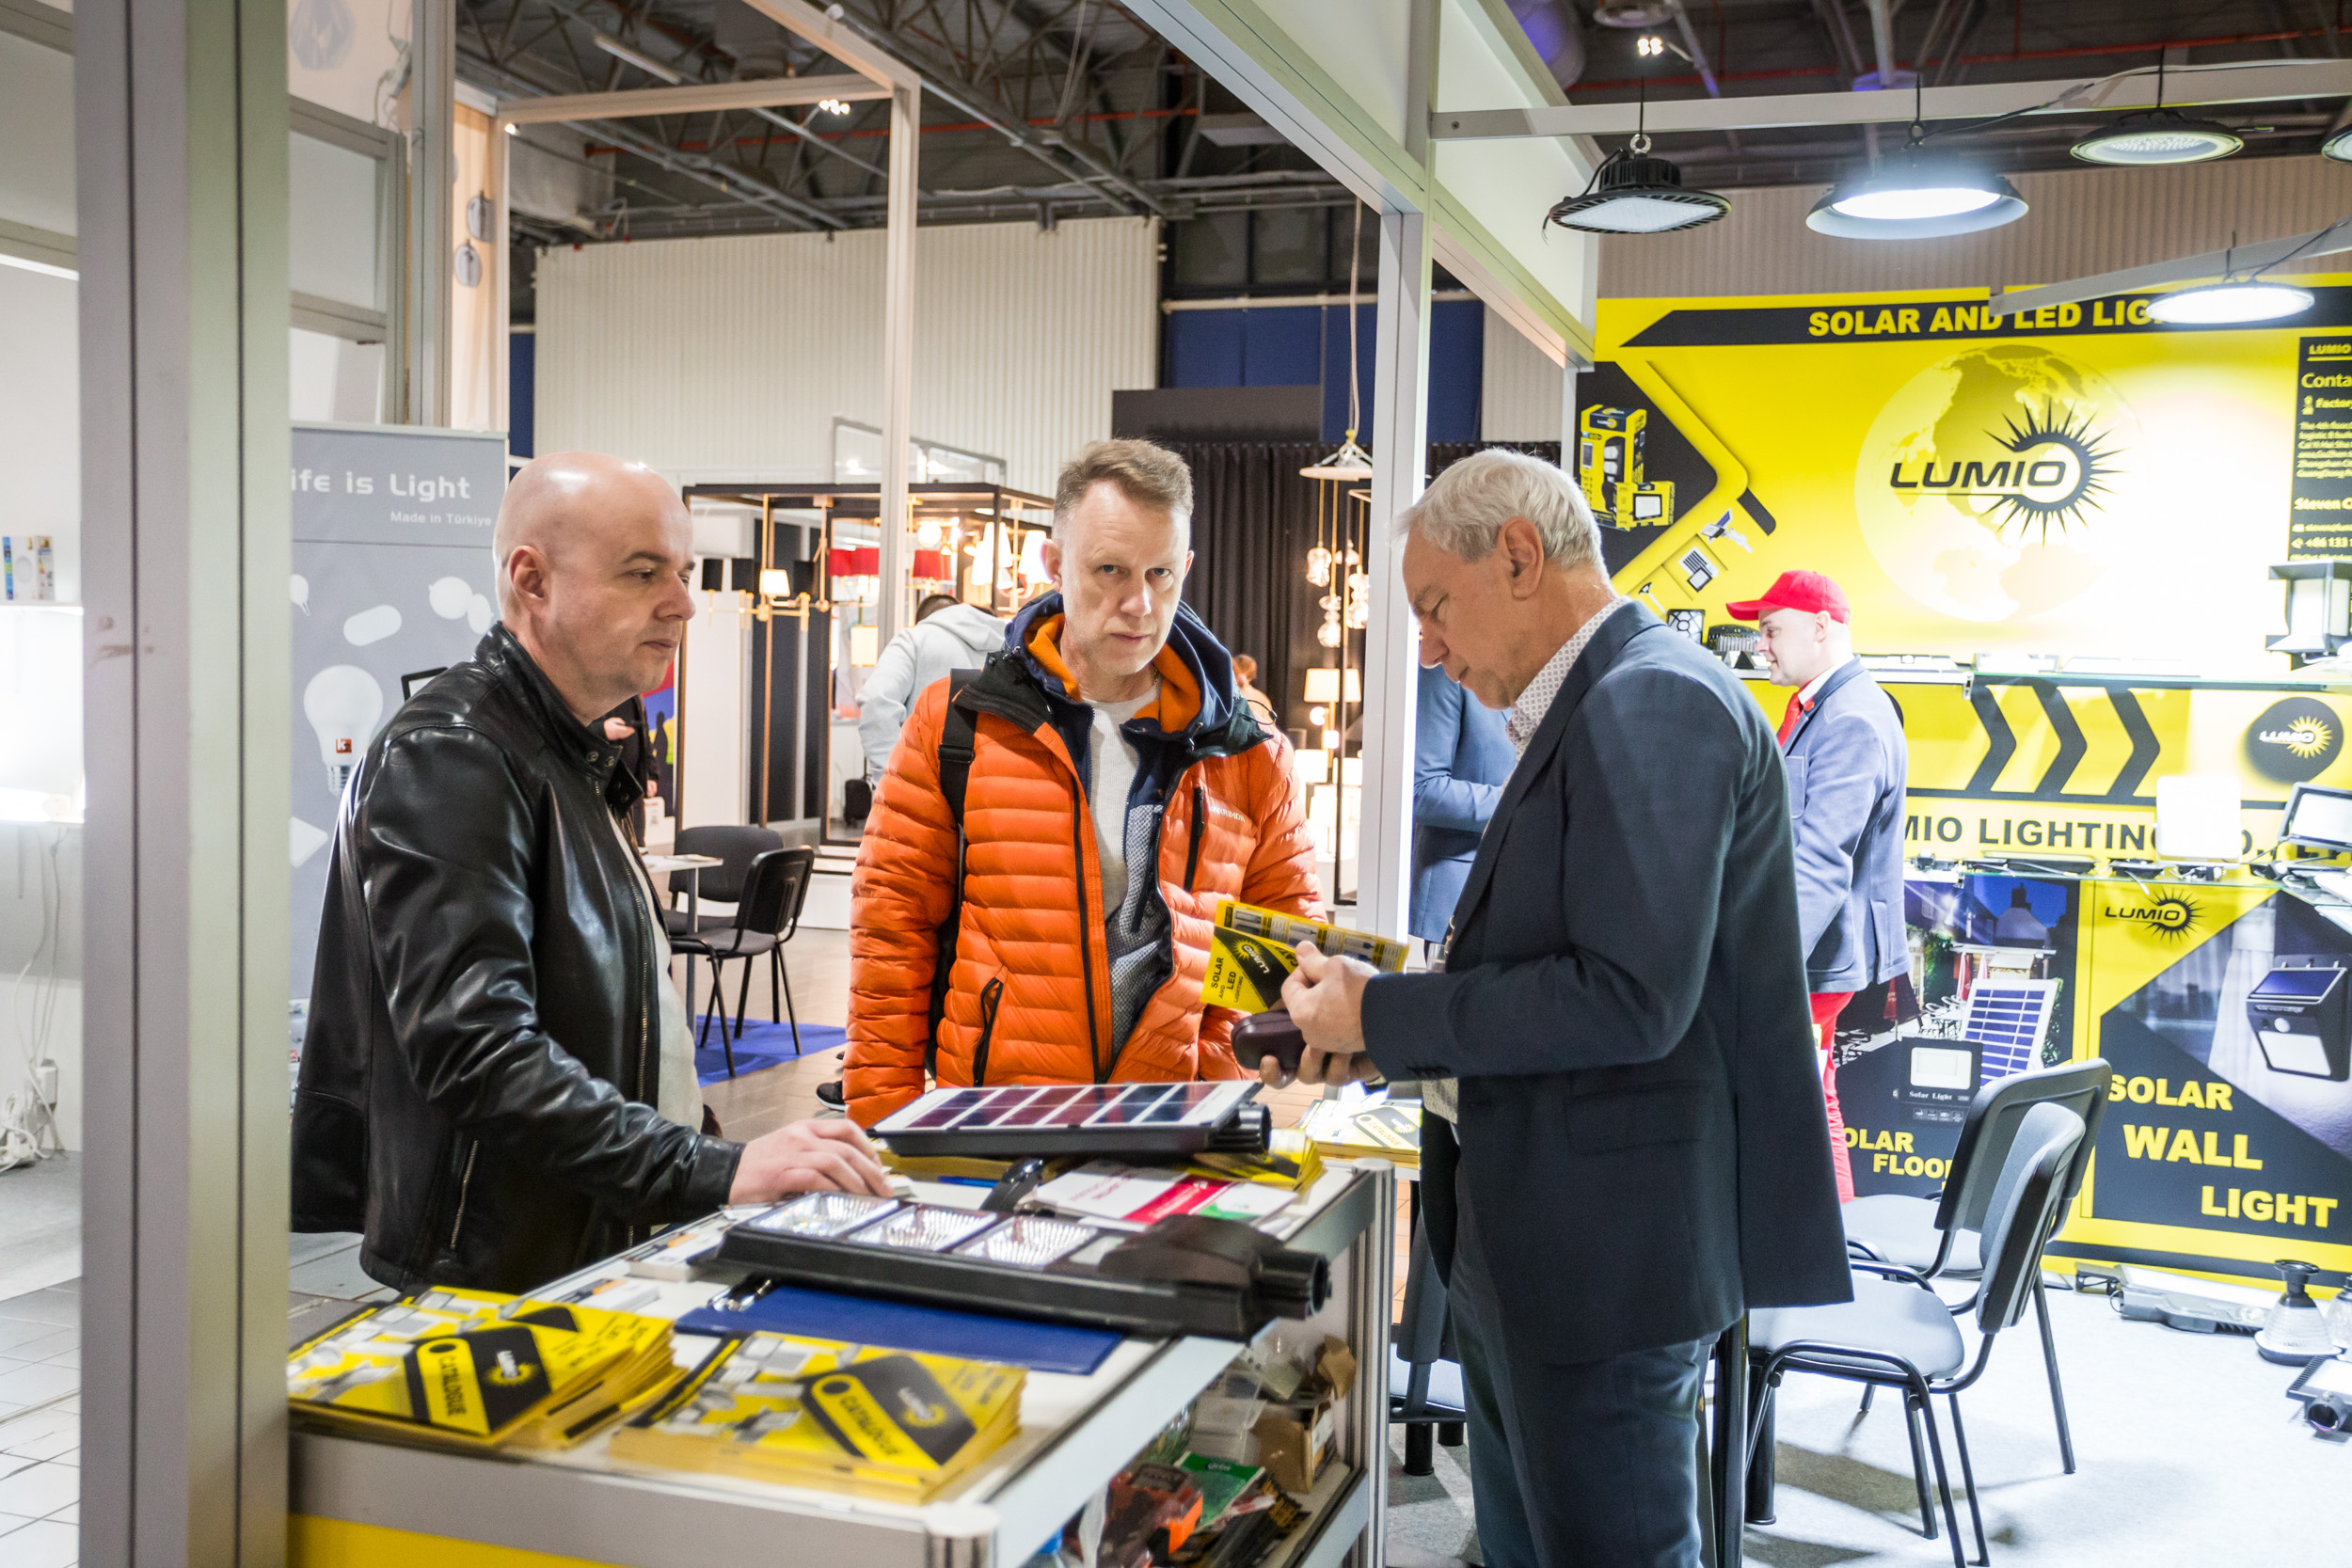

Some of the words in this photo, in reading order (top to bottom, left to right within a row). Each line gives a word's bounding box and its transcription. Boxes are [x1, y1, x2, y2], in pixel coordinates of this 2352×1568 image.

[1808, 309, 1920, 336] SOLAR
[1930, 306, 2003, 332] AND
[2014, 303, 2082, 329] LED
[2092, 299, 2163, 326] LIG
[291, 468, 330, 492] ife
[346, 471, 373, 494] is
[389, 474, 470, 502] Light
[1890, 461, 2066, 487] LUMIO
[390, 511, 425, 523] Made
[430, 514, 442, 523] in
[2259, 731, 2315, 743] LUMIO
[1905, 816, 1963, 842] MIO
[1979, 818, 2155, 850] LIGHTIN
[2105, 907, 2180, 921] LUMIO
[1211, 957, 1225, 989] SOLAR
[1244, 944, 1270, 974] LUMIO
[1226, 971, 1237, 990] LED
[1931, 1093, 1953, 1101] Light
[2108, 1074, 2233, 1111] SOLAR
[1844, 1127, 1915, 1153] OLAR
[2122, 1124, 2264, 1170] WALL
[2201, 1185, 2339, 1228] LIGHT
